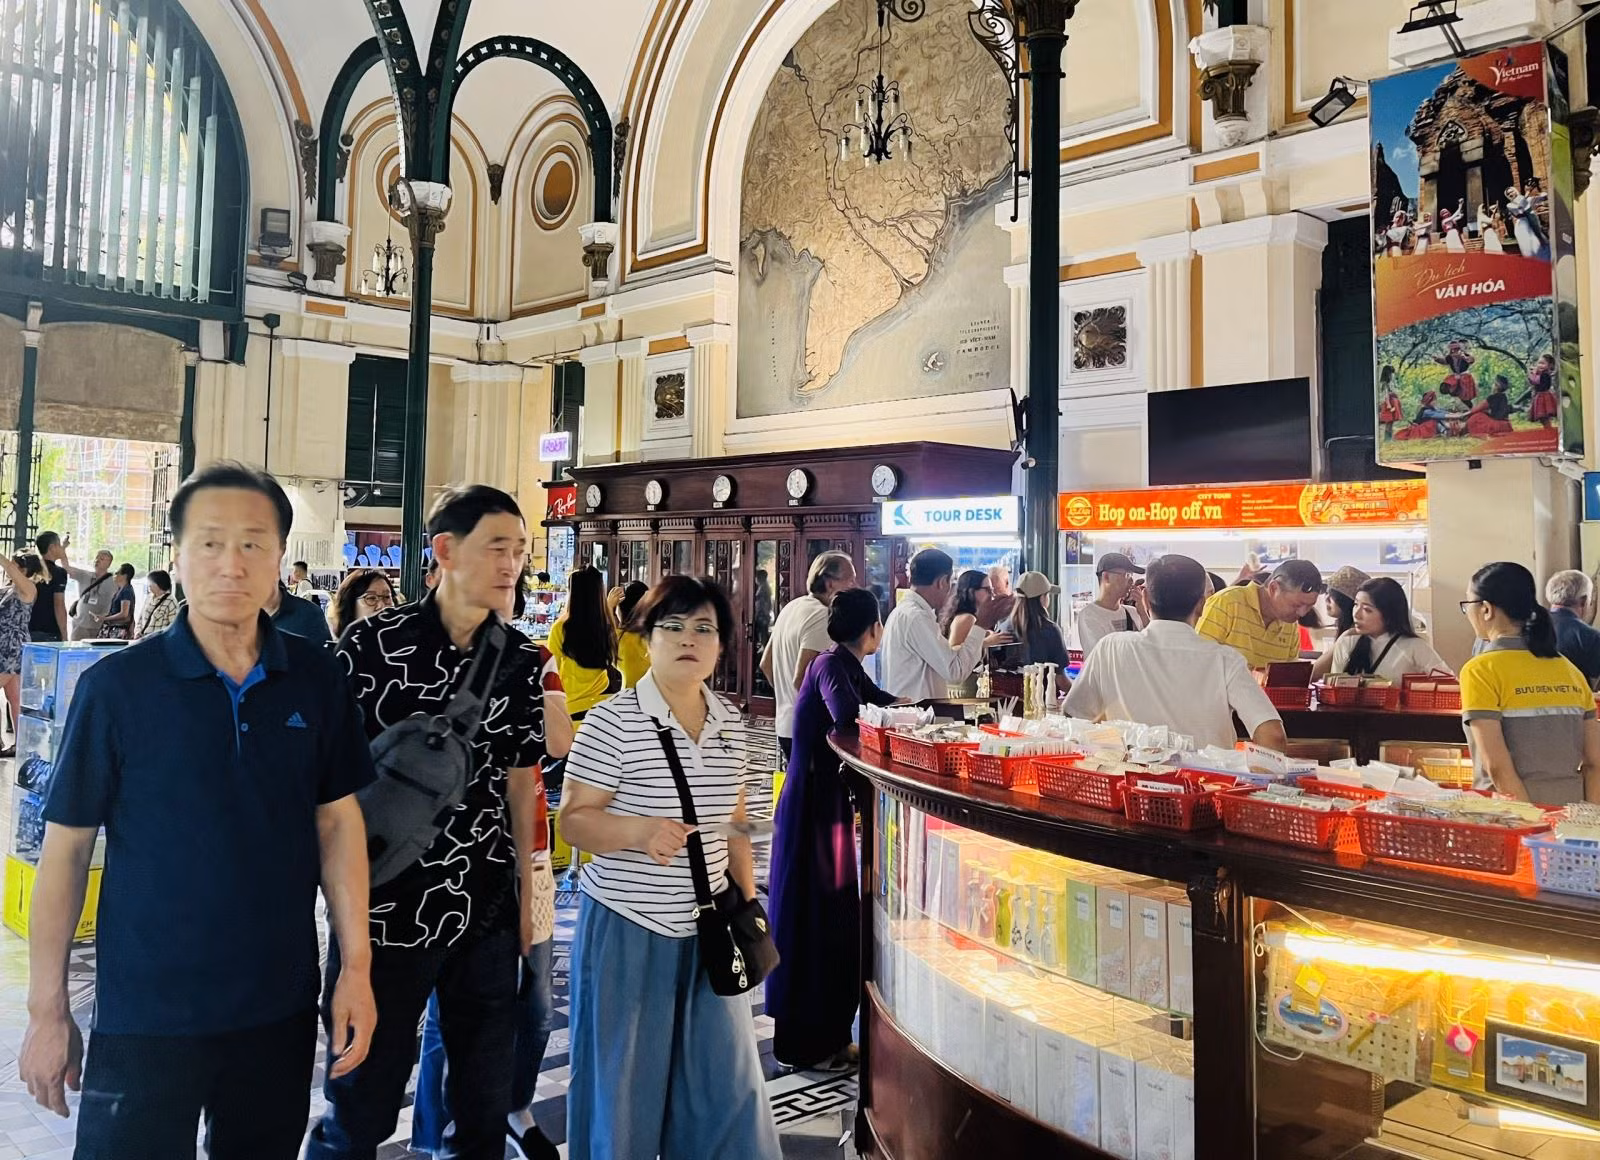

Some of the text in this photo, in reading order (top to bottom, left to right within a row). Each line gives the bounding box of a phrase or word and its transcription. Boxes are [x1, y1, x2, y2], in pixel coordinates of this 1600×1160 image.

[1488, 62, 1539, 86] Vietnam
[1435, 278, 1505, 299] VĂN HÓA
[924, 508, 1003, 522] TOUR DESK
[1099, 504, 1125, 526] Hop
[1129, 502, 1177, 525] on-Hop
